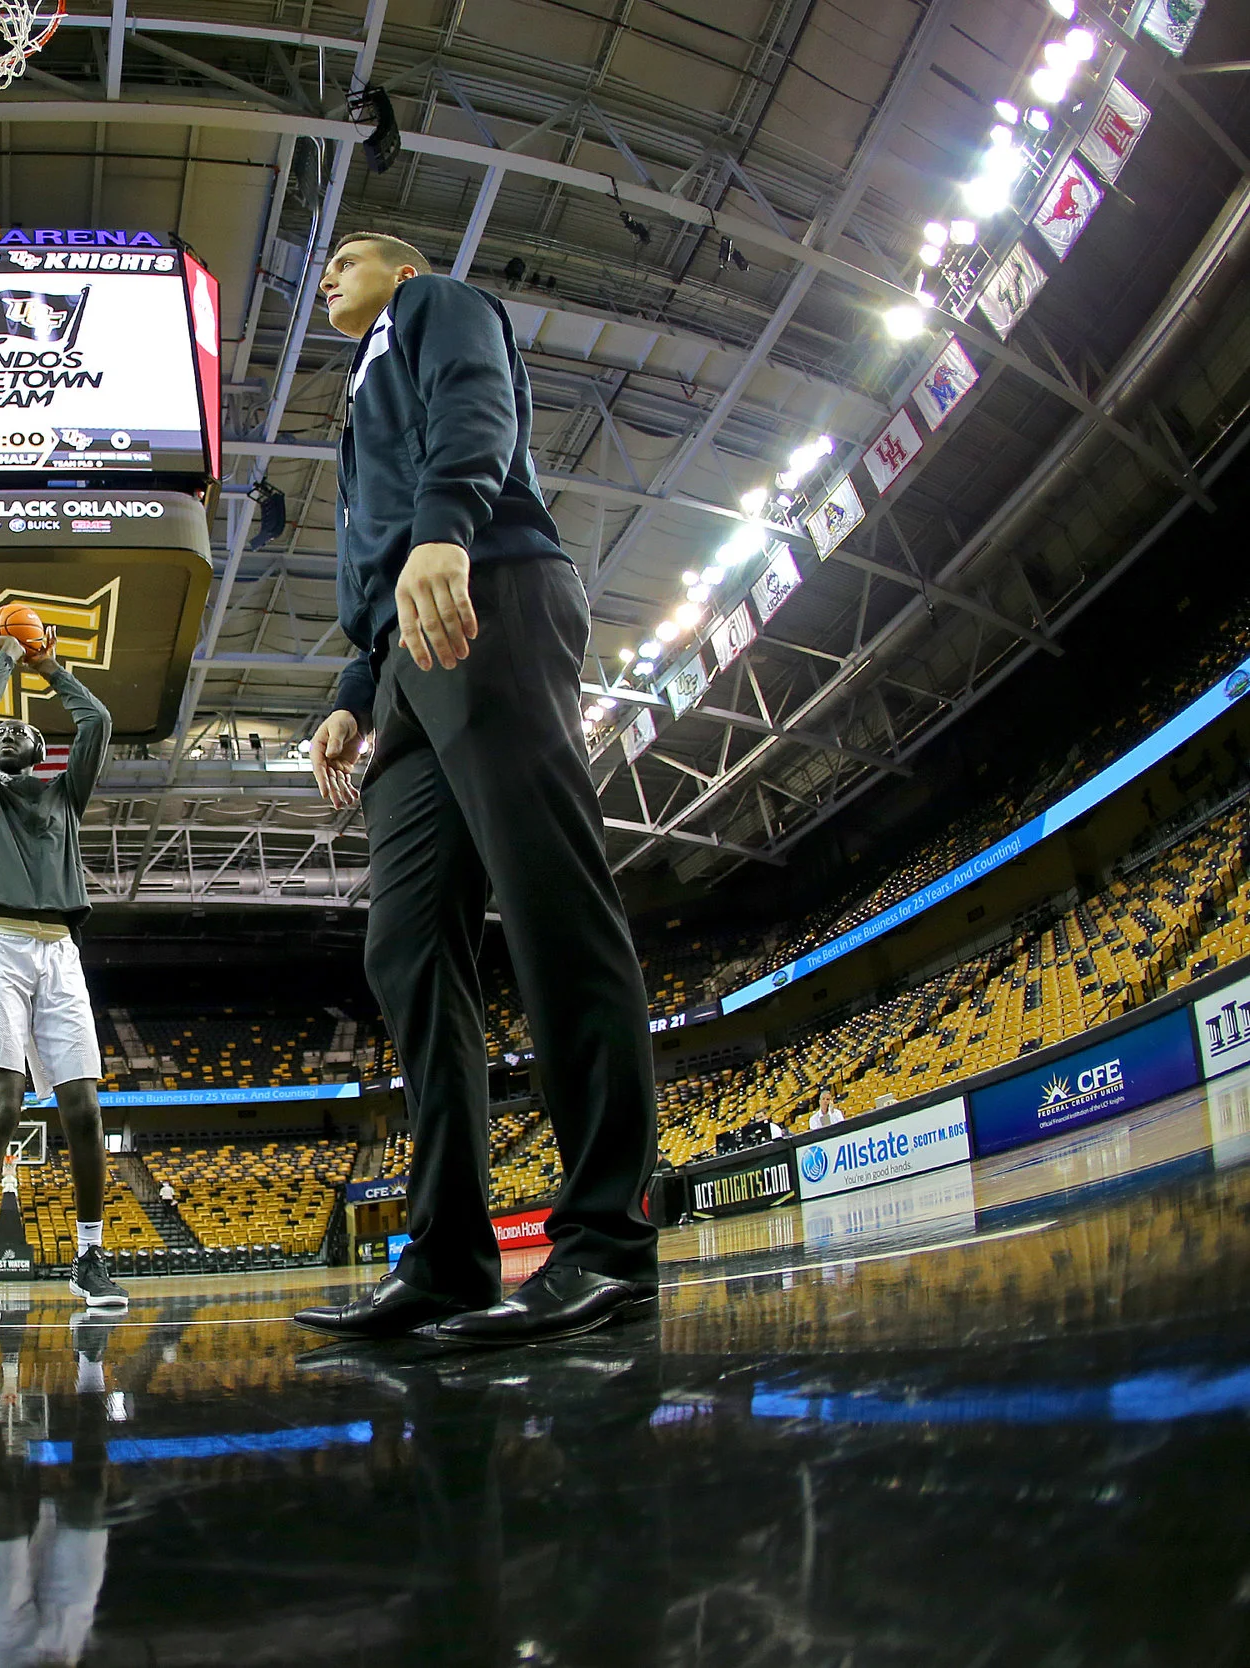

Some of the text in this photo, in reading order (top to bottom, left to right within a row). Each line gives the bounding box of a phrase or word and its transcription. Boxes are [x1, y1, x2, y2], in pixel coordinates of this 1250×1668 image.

[0, 229, 162, 247] ARENA
[43, 251, 176, 272] KNIGHTS
[110, 430, 132, 450] 0
[62, 500, 165, 518] ORLANDO
[27, 520, 61, 531] BUICK
[767, 583, 792, 613] UCONN
[675, 671, 698, 697] UCF
[806, 836, 1022, 968] The Best in the Business for 25 Years. And Counting!
[670, 1013, 686, 1028] 21
[1077, 1058, 1123, 1093] CFE
[99, 1088, 318, 1104] est in the Business for 25 Years. And Counting!
[1038, 1082, 1124, 1118] FEDERAL CREDIT UNION
[913, 1130, 937, 1149] SCOTT
[938, 1128, 948, 1141] M.
[833, 1131, 909, 1174] Allstate
[844, 1161, 913, 1185] You're in good hands.
[365, 1187, 389, 1198] CFE
[694, 1163, 791, 1210] UCFKNIGHTS.COM
[497, 1221, 545, 1240] FLORIDA HOSPIT
[8, 1260, 30, 1268] WATCH
